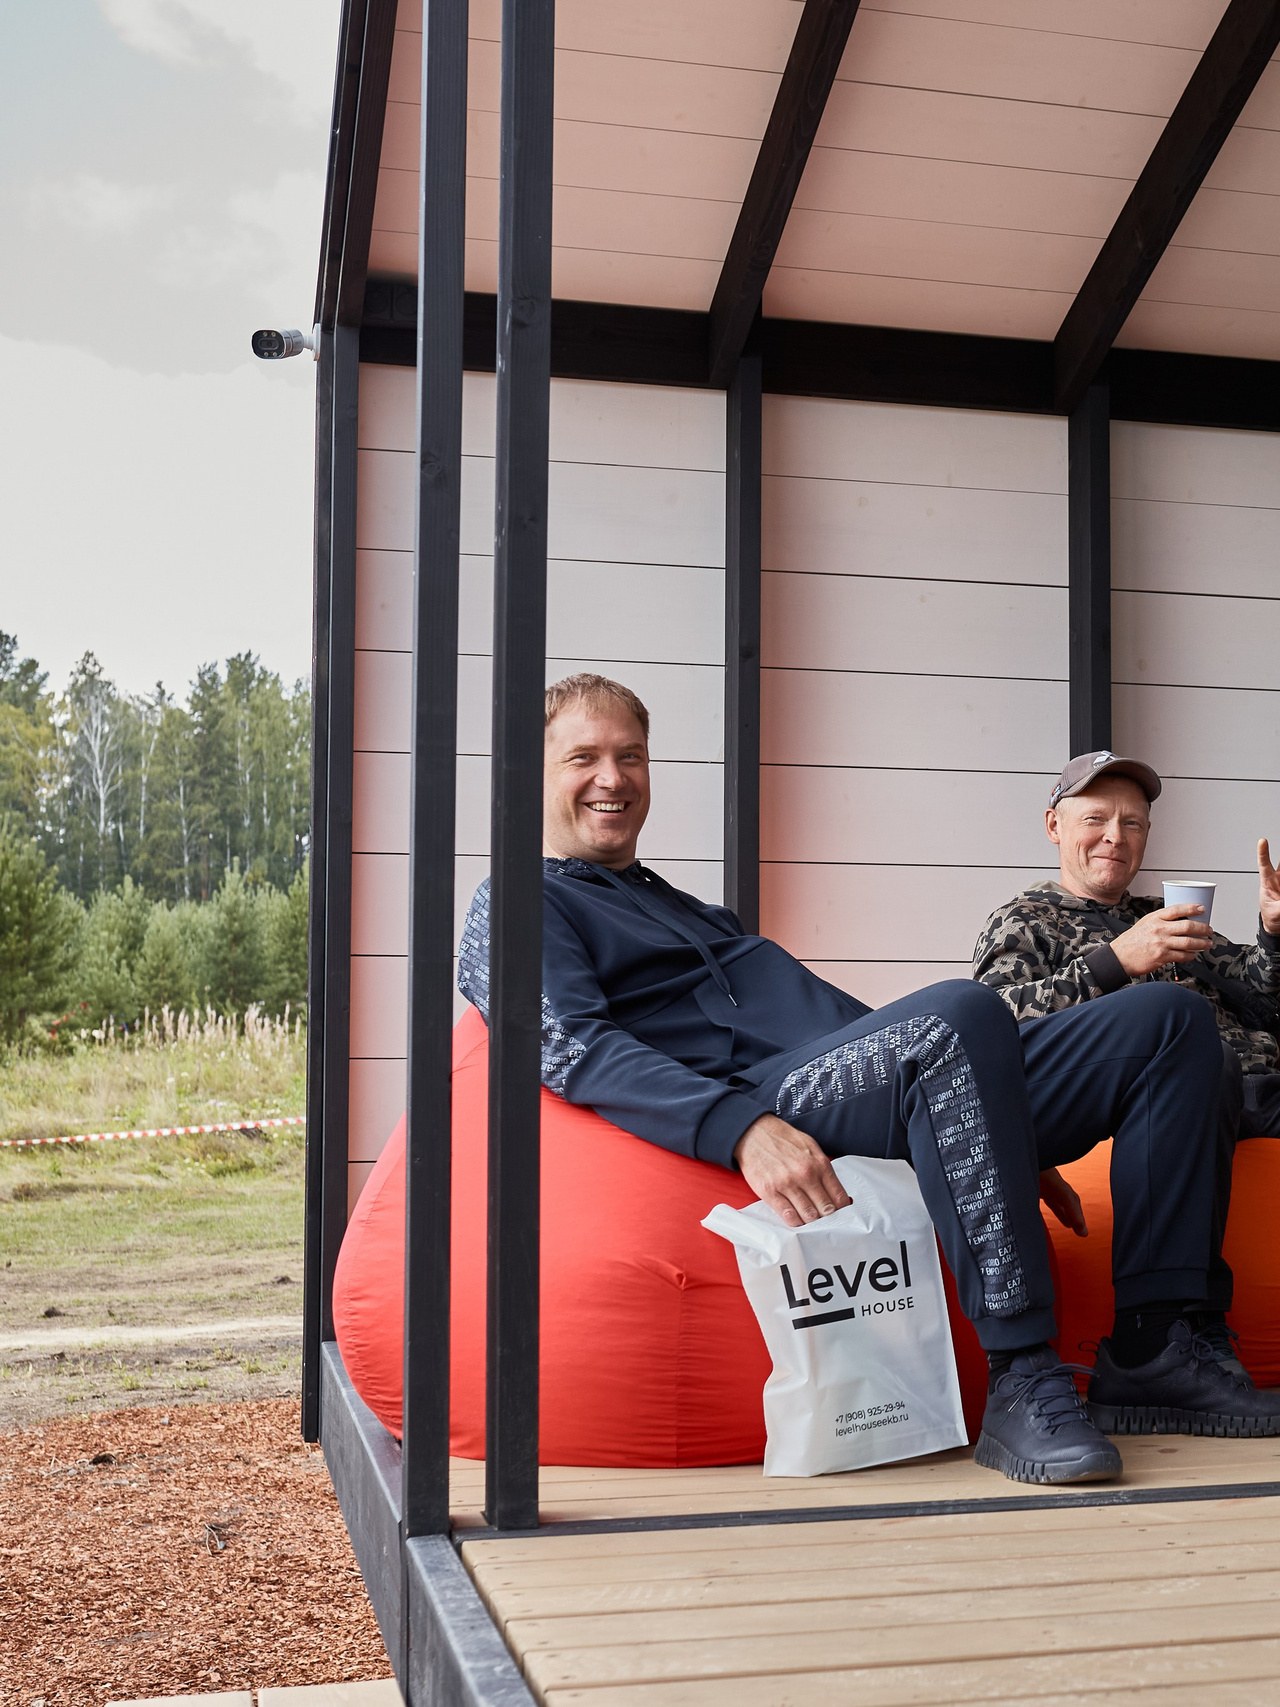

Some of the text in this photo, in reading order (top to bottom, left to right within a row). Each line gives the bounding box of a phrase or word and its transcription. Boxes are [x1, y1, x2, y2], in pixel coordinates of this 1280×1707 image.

[952, 1075, 966, 1088] EA7
[934, 1094, 967, 1113] EMPORIO
[960, 1109, 975, 1122] EA7
[942, 1128, 976, 1147] EMPORIO
[970, 1143, 984, 1156] EA7
[952, 1162, 985, 1180] EMPORIO
[980, 1177, 994, 1189] EA7
[961, 1196, 995, 1213] EMPORIO
[990, 1211, 1004, 1223] EA7
[972, 1230, 1004, 1246] EMPORIO
[998, 1244, 1012, 1257] EA7
[780, 1240, 912, 1309] Level
[1006, 1277, 1021, 1289] EA7
[861, 1296, 915, 1316] HOUSE
[835, 1401, 906, 1424] +7 (908) 925-29-94
[835, 1413, 910, 1437] levelhouseekb.ru
